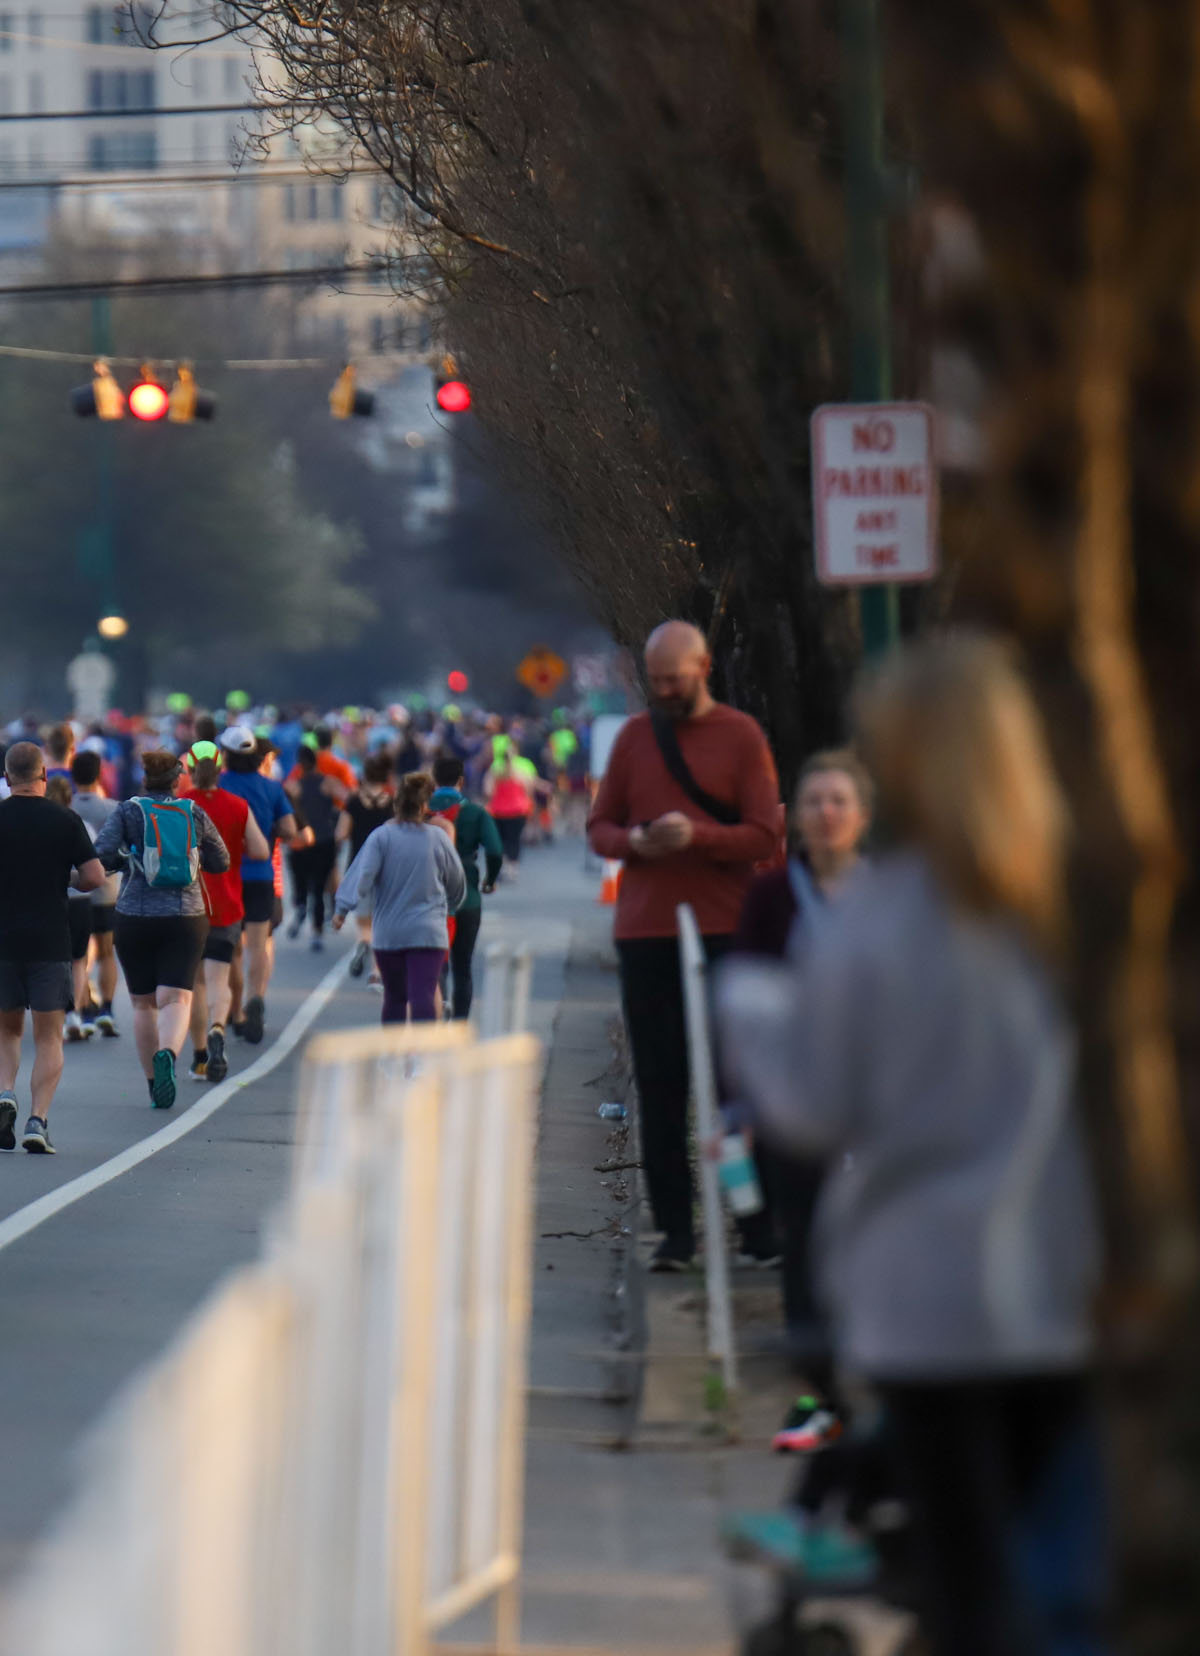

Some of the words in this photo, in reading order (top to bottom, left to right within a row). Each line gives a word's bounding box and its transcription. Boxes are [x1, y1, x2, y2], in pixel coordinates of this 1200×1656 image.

[852, 420, 896, 454] NO
[824, 467, 923, 497] PARKING
[855, 510, 898, 533] ANY
[856, 544, 900, 568] TIME
